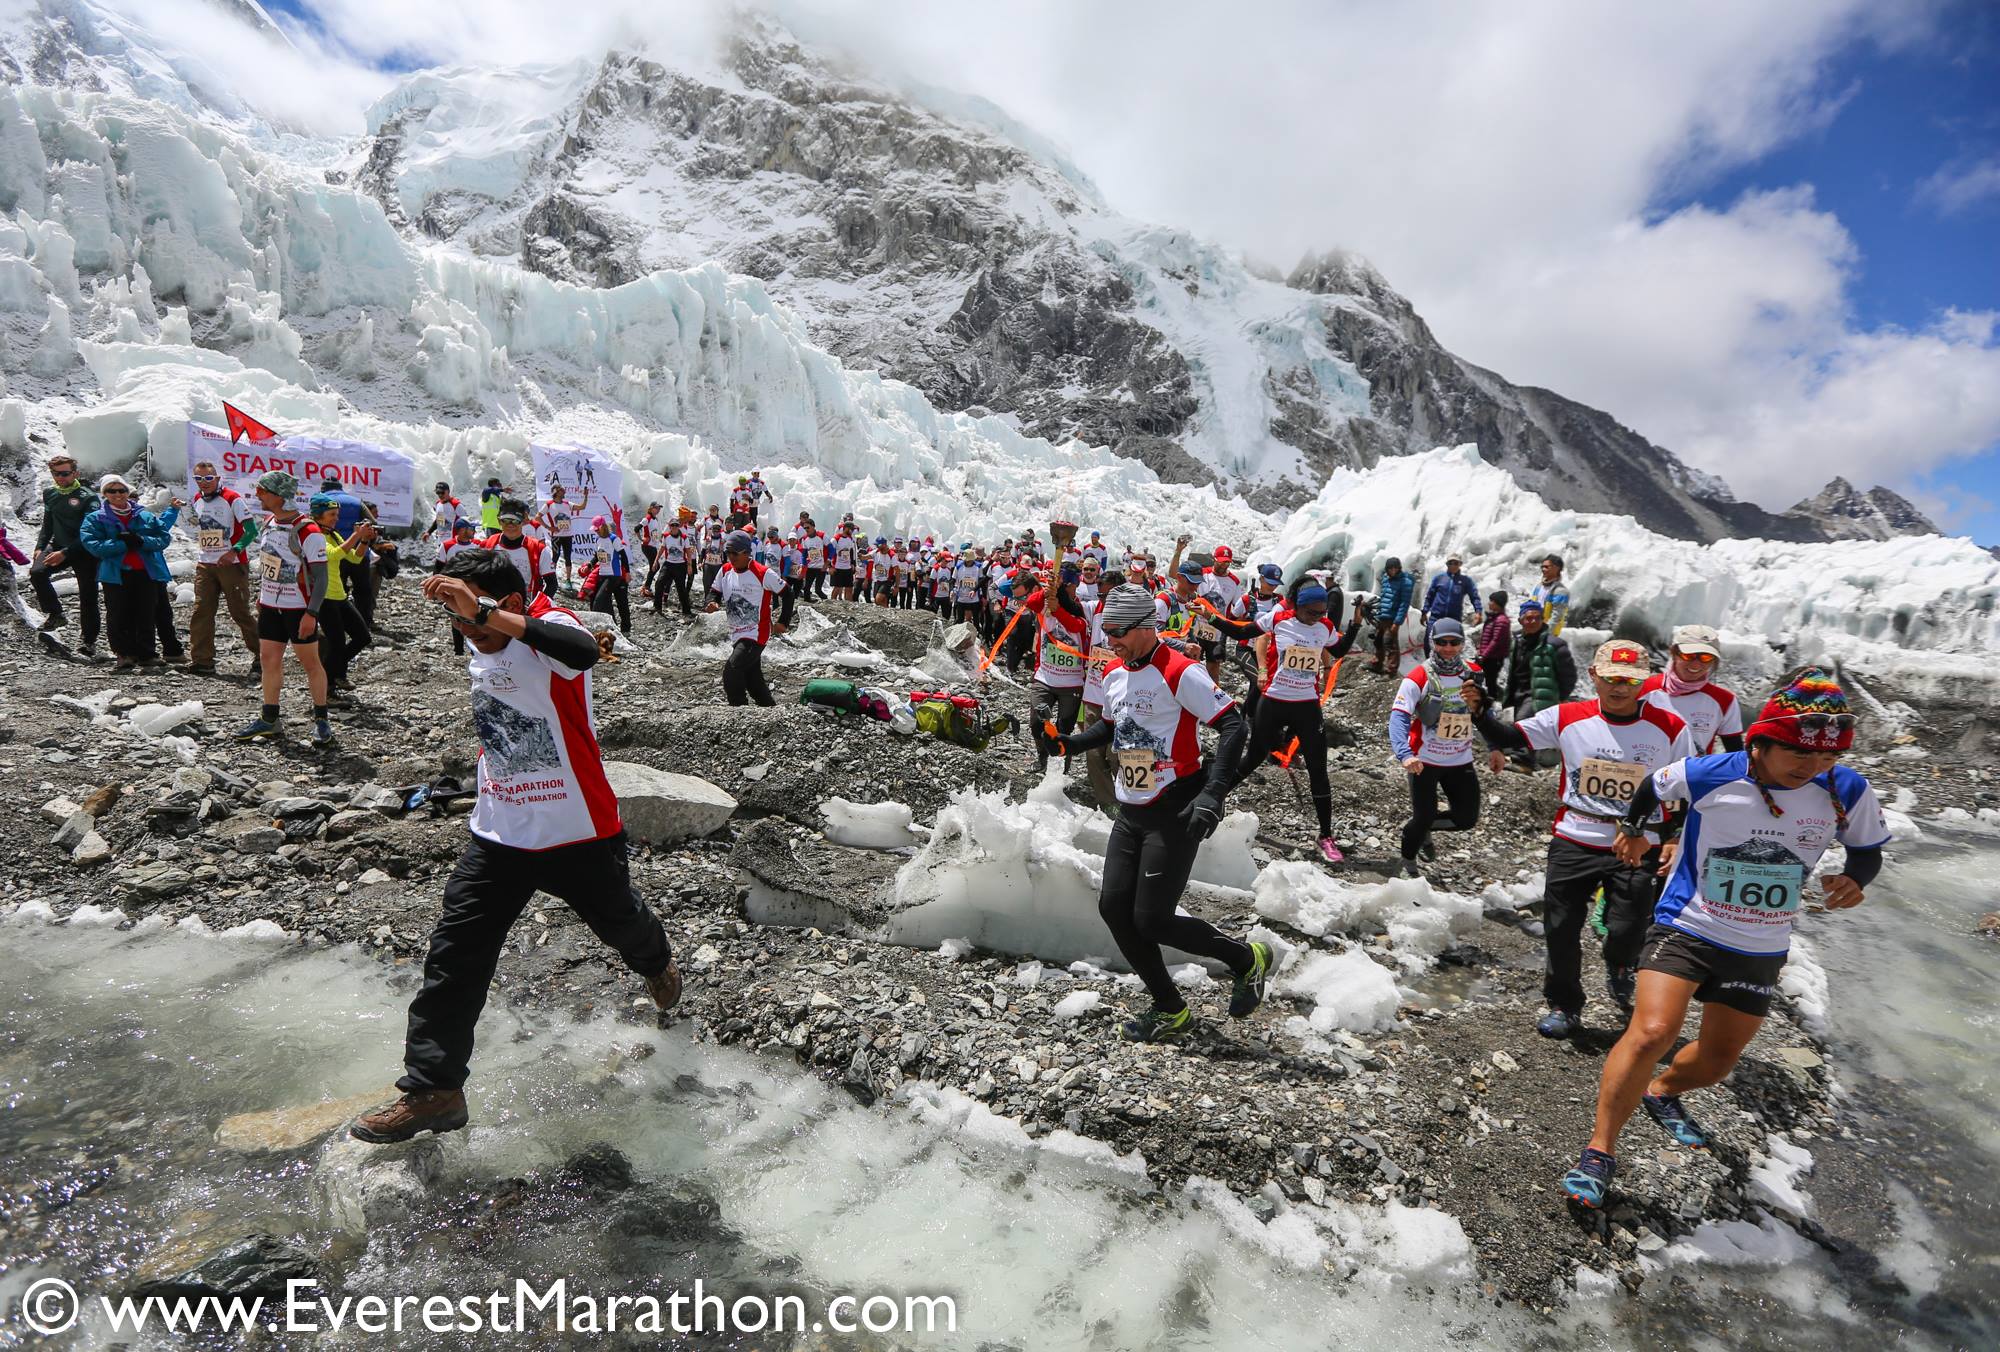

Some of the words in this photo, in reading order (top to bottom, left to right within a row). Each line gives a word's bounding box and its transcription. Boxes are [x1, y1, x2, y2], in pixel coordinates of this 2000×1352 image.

[223, 452, 296, 475] START
[305, 462, 382, 487] POINT
[201, 537, 220, 547] 022
[1050, 653, 1074, 667] 186
[1288, 656, 1316, 671] 012
[1134, 689, 1158, 698] MOUNT
[1444, 724, 1469, 738] 124
[1631, 743, 1661, 753] MOUNT
[505, 779, 565, 795] MARATHON
[1586, 776, 1635, 801] 069
[527, 792, 568, 803] MARATHON
[1796, 817, 1831, 828] MOUNT
[1751, 829, 1785, 837] 8848m
[1719, 879, 1788, 909] 160
[1701, 904, 1732, 920] WORLD'S
[1702, 896, 1747, 915] EVEREST
